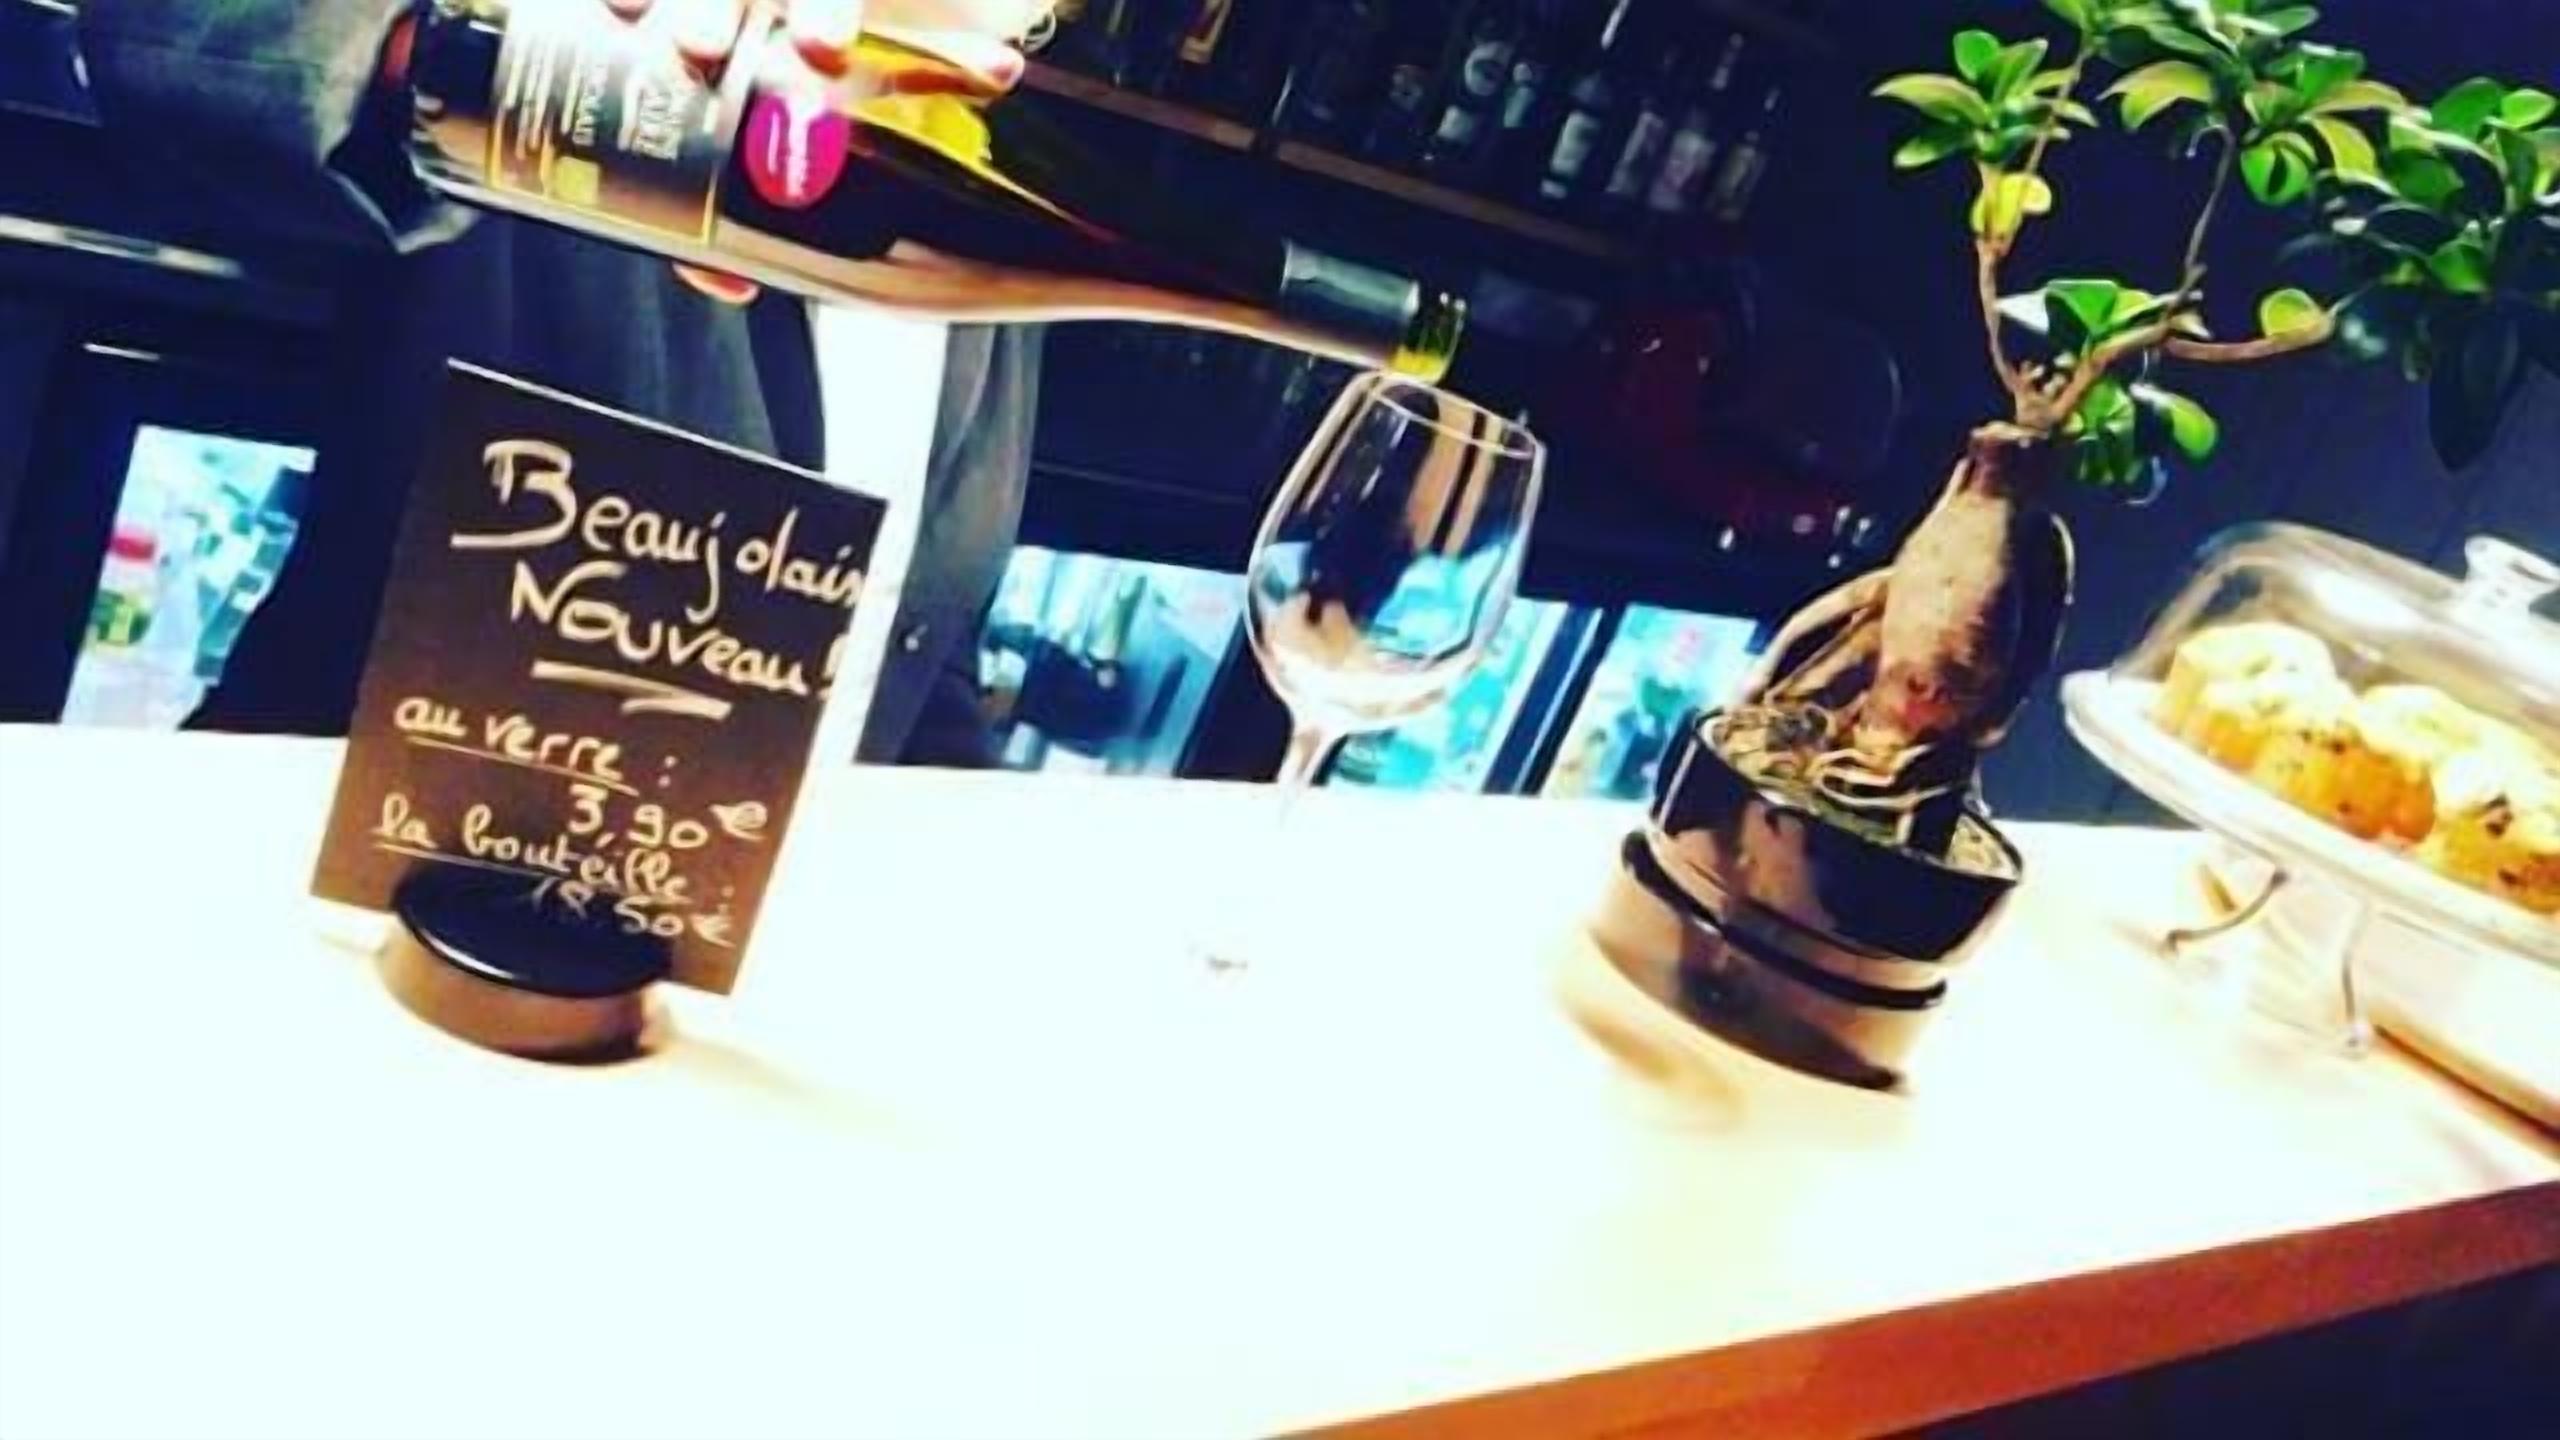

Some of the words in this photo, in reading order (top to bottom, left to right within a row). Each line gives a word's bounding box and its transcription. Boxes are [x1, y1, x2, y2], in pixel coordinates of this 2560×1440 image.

[451, 439, 864, 623] Beaujolais
[394, 698, 468, 737] au
[485, 712, 624, 782] verre
[374, 792, 437, 849] la
